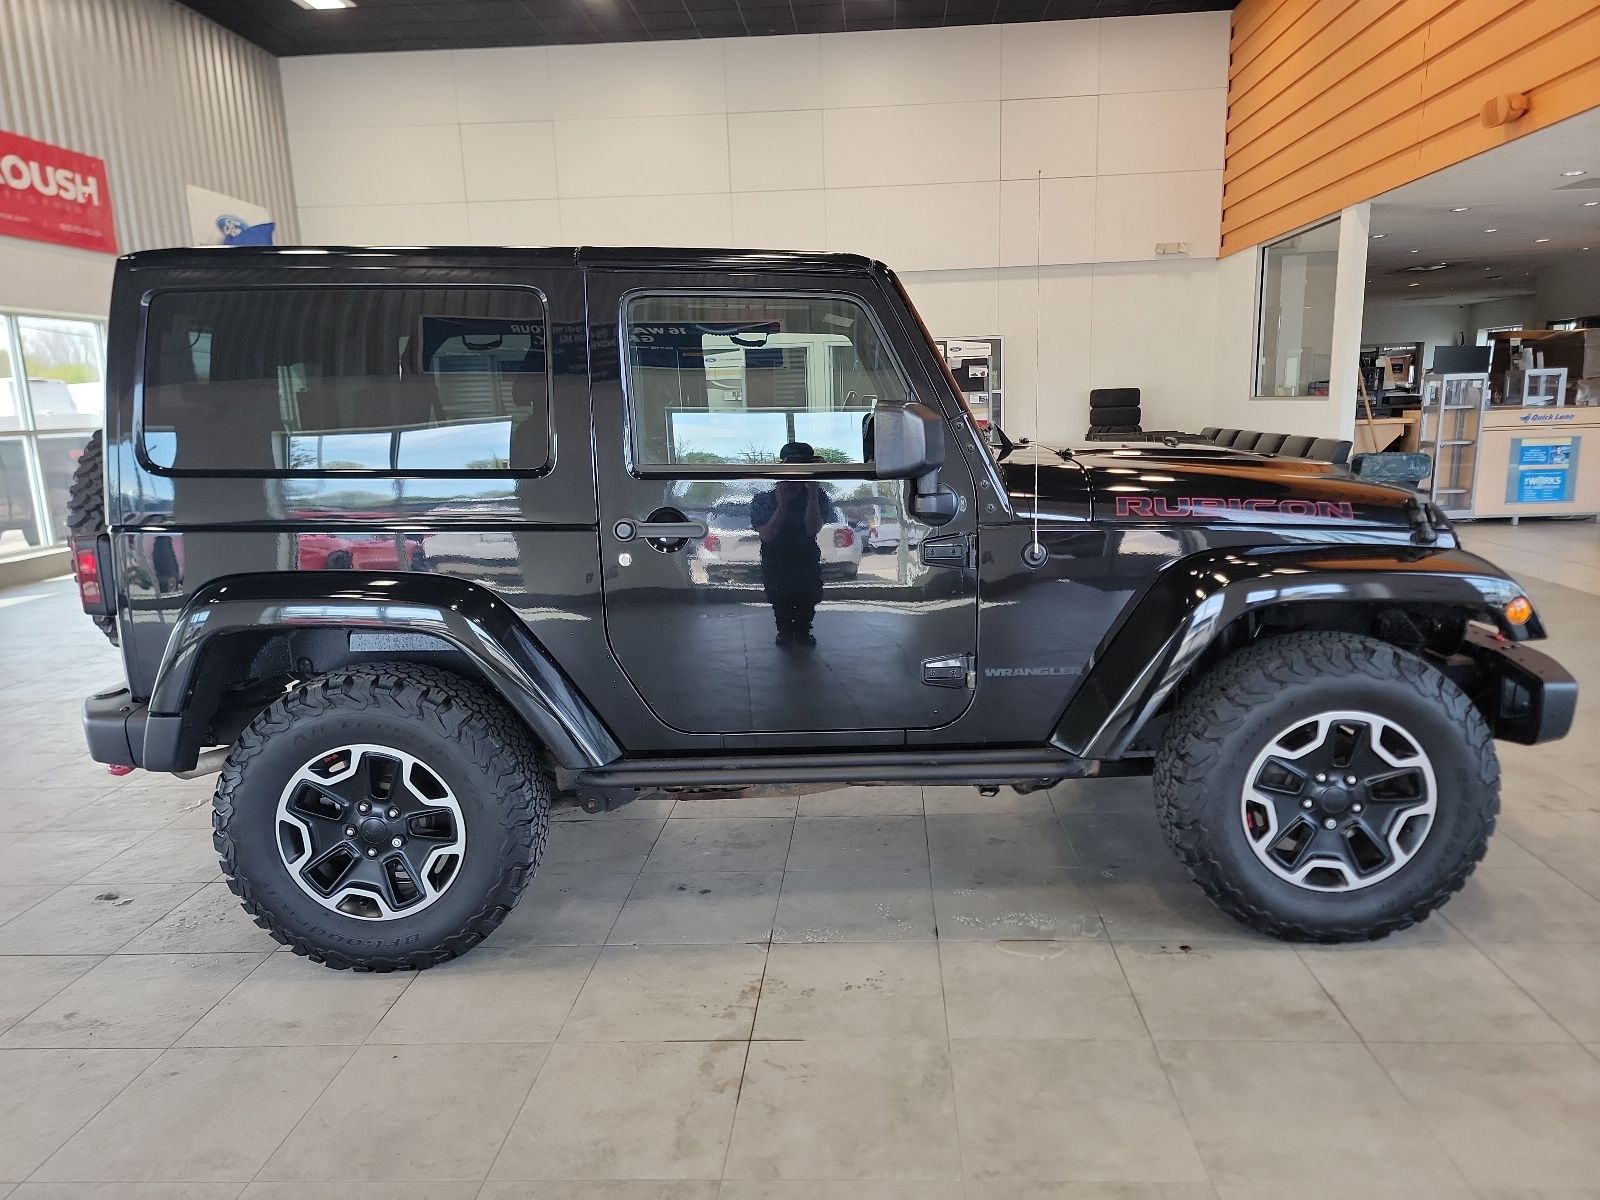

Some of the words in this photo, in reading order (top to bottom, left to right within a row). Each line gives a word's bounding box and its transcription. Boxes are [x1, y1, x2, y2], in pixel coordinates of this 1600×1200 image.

[0, 154, 100, 207] OUSH
[1115, 496, 1354, 520] RUBICON
[984, 667, 1084, 677] WRANGLER
